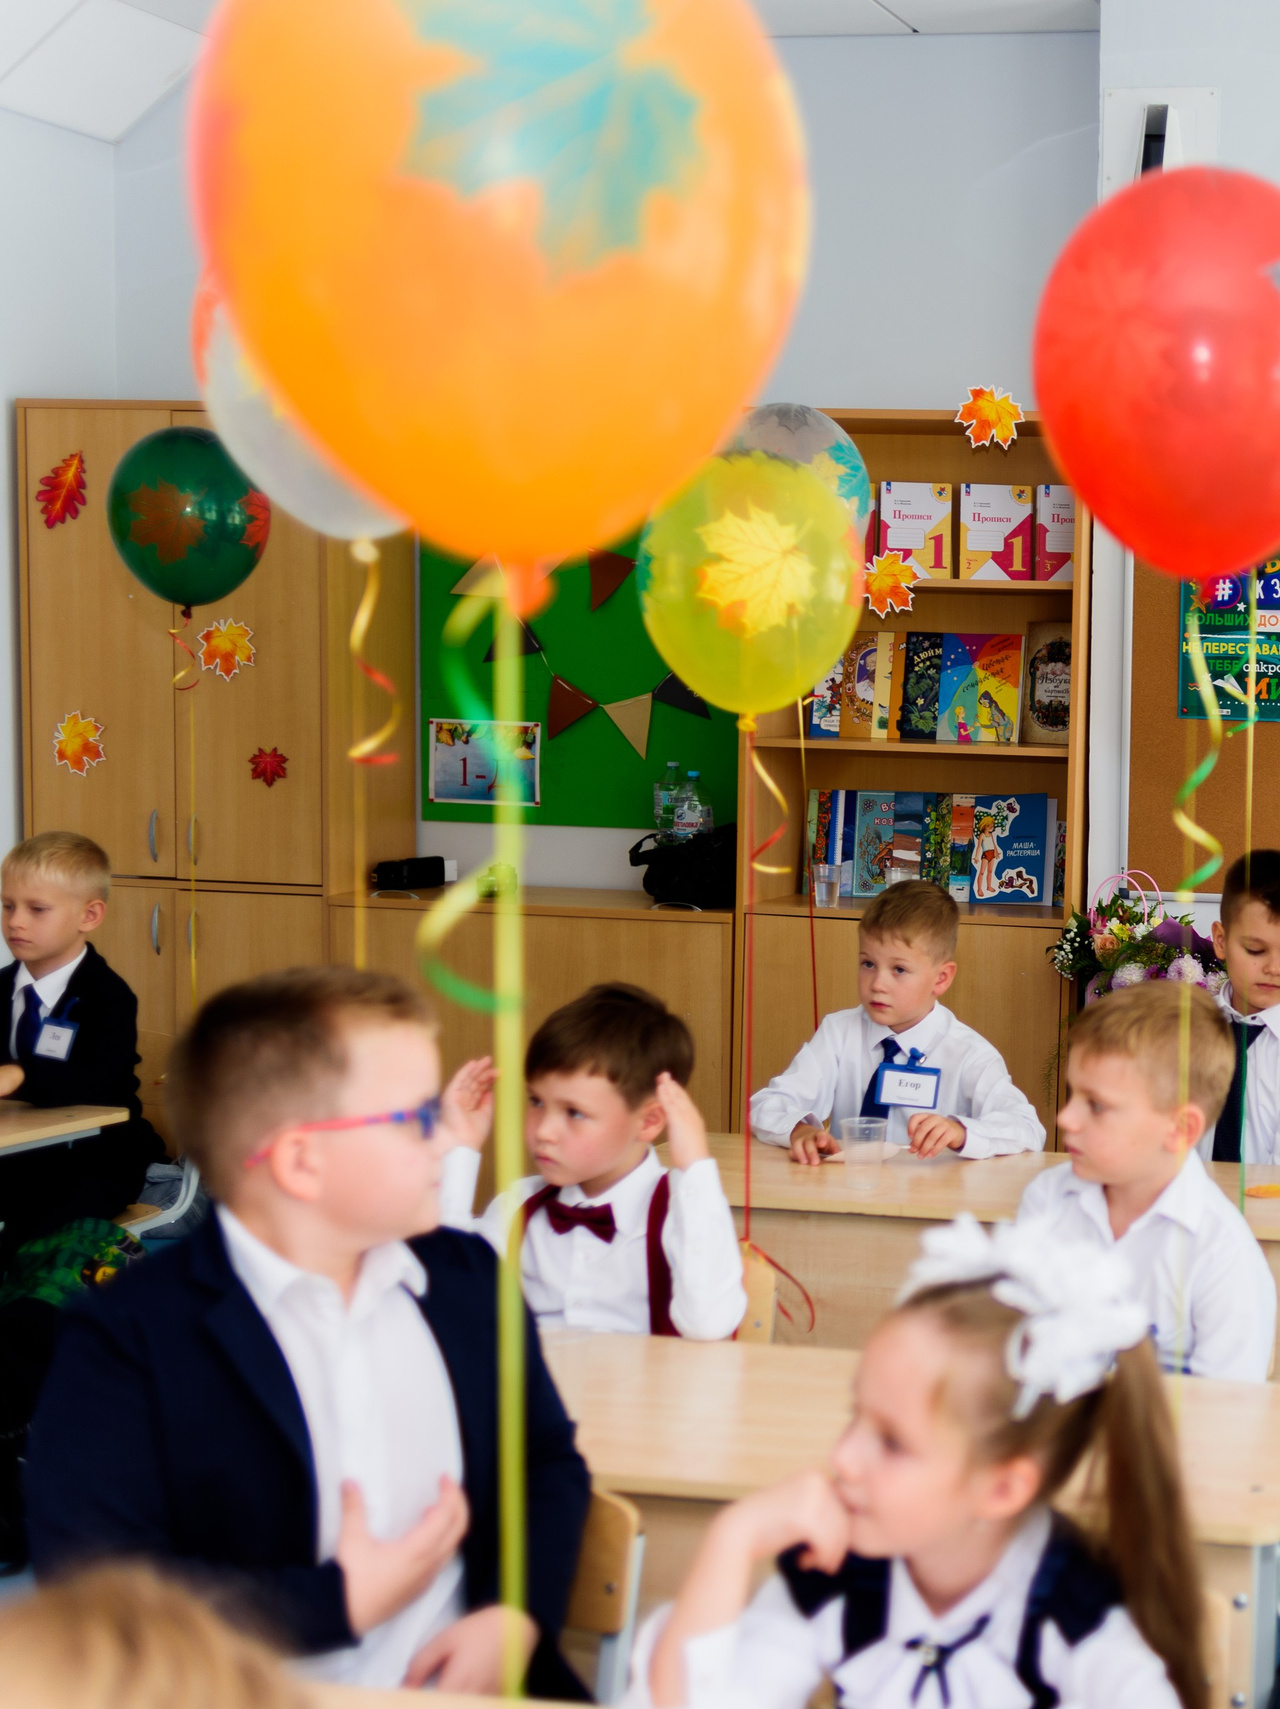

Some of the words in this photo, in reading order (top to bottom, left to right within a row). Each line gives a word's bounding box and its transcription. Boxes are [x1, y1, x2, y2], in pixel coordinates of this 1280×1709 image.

[893, 510, 932, 521] Прописи
[972, 512, 1012, 523] Прописи
[928, 533, 948, 569] 1
[1007, 535, 1027, 571] 1
[1006, 849, 1041, 857] РАСТЕРЯША
[898, 1079, 921, 1090] Егор
